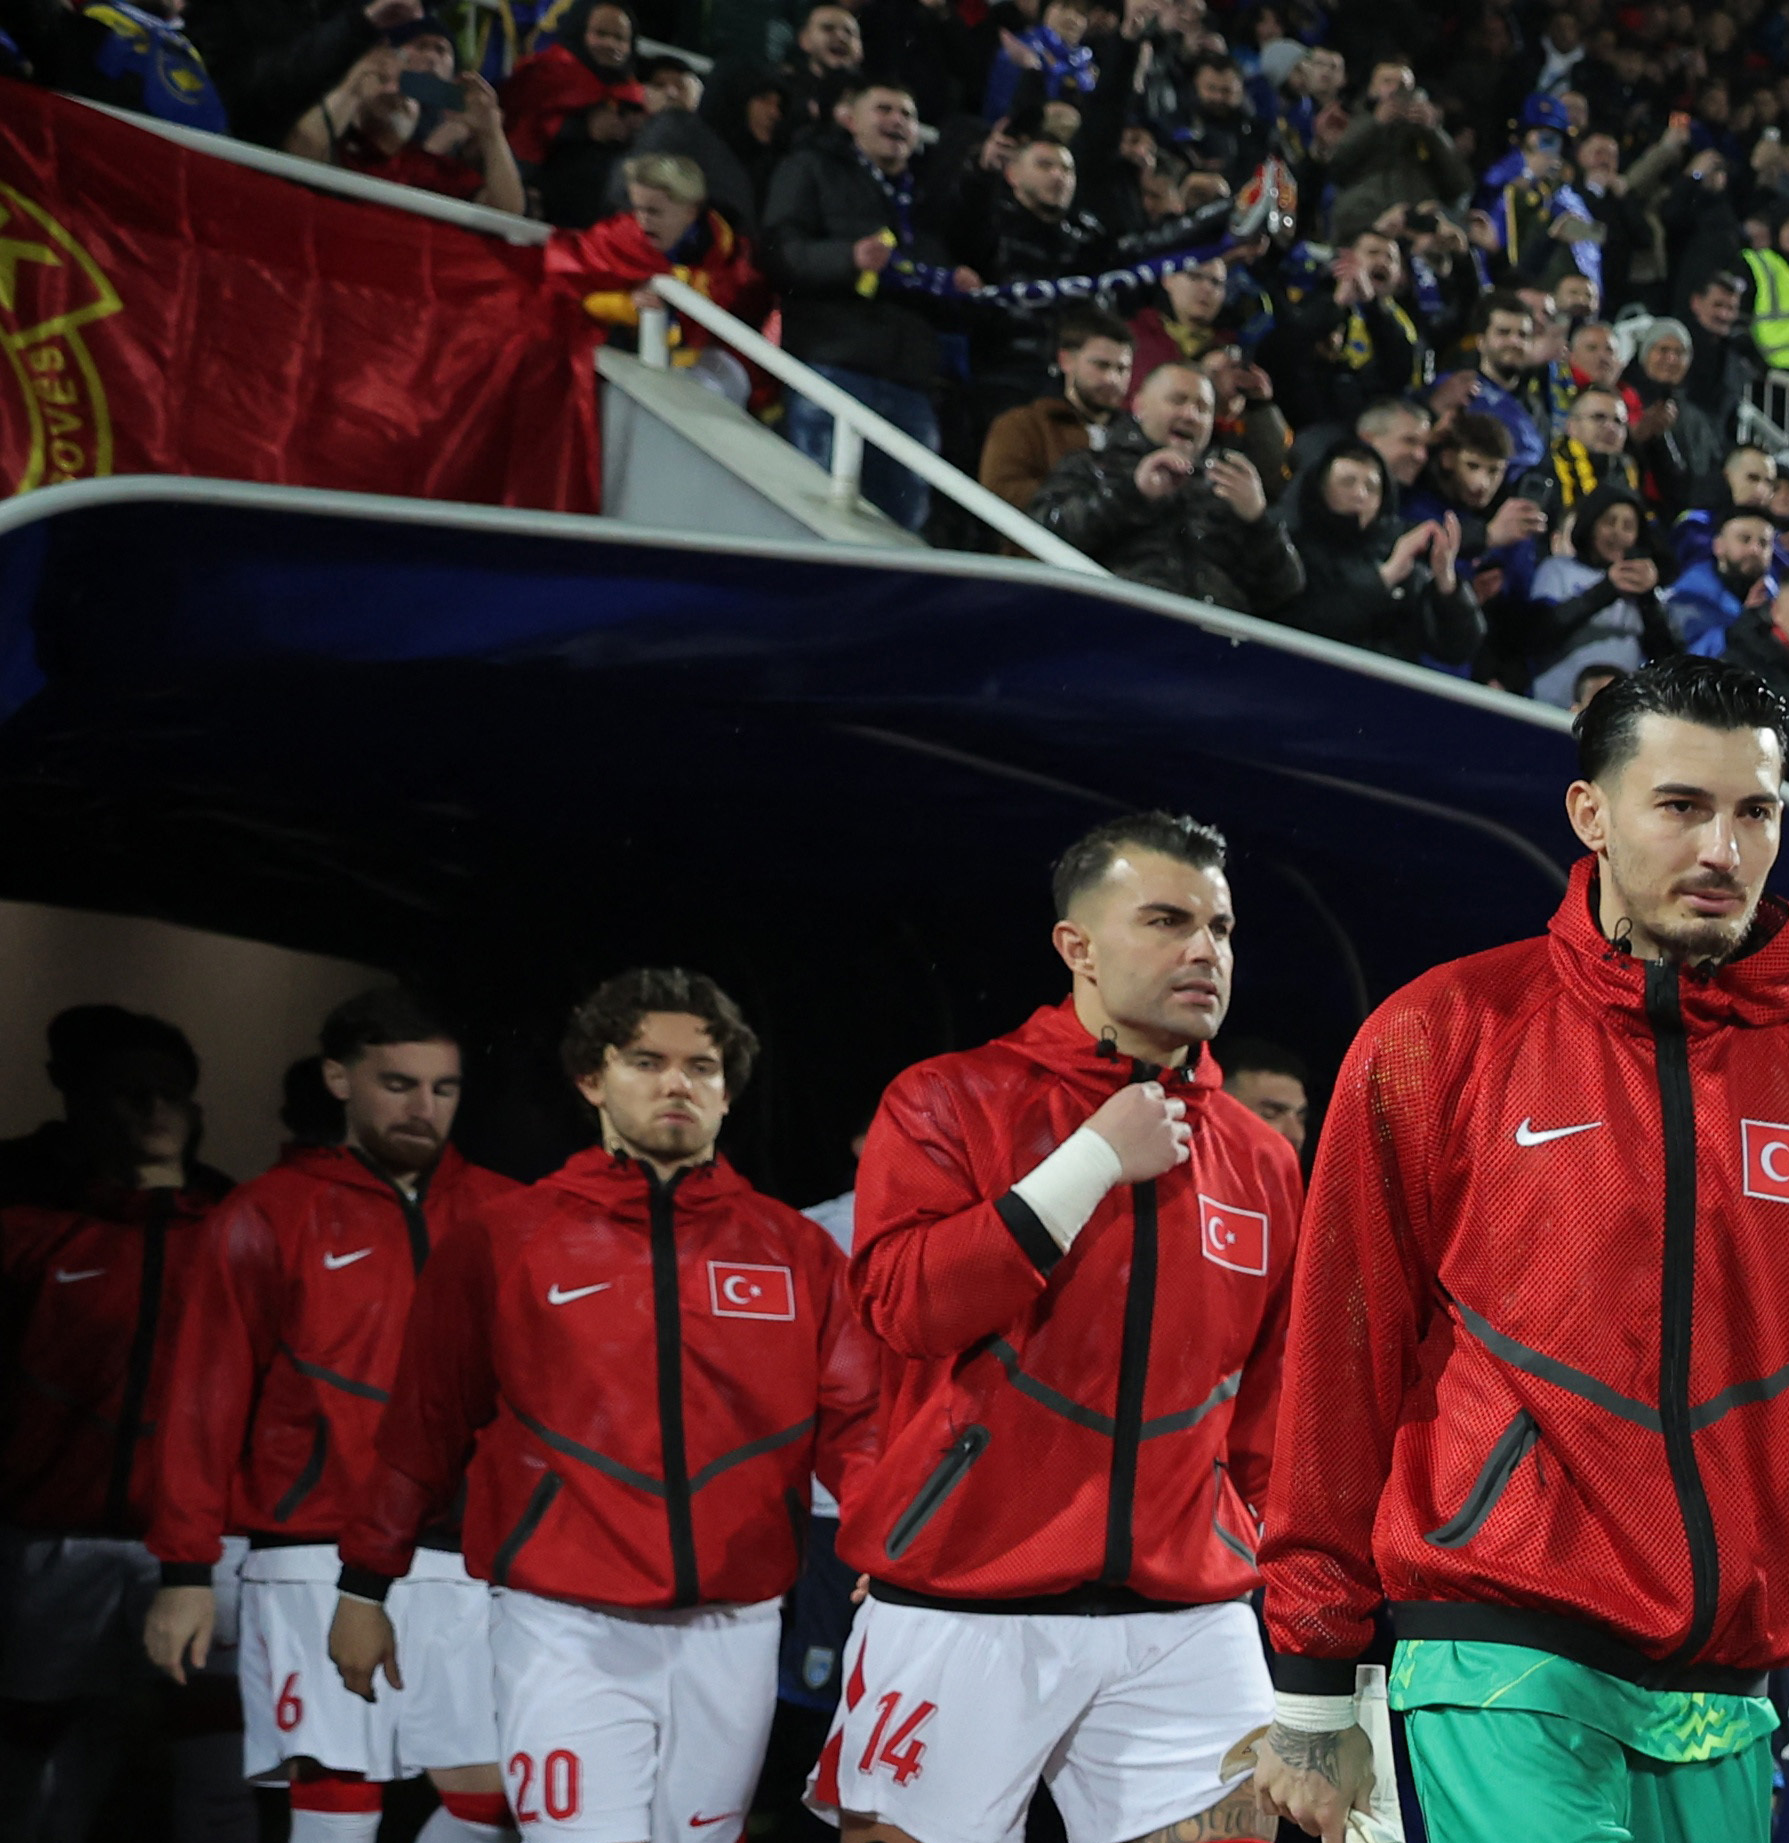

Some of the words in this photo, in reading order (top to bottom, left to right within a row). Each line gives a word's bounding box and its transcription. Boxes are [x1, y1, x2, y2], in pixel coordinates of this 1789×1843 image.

[29, 346, 86, 481] OVES
[276, 1672, 303, 1732] 6
[858, 1690, 938, 1786] 14
[507, 1748, 582, 1823] 20
